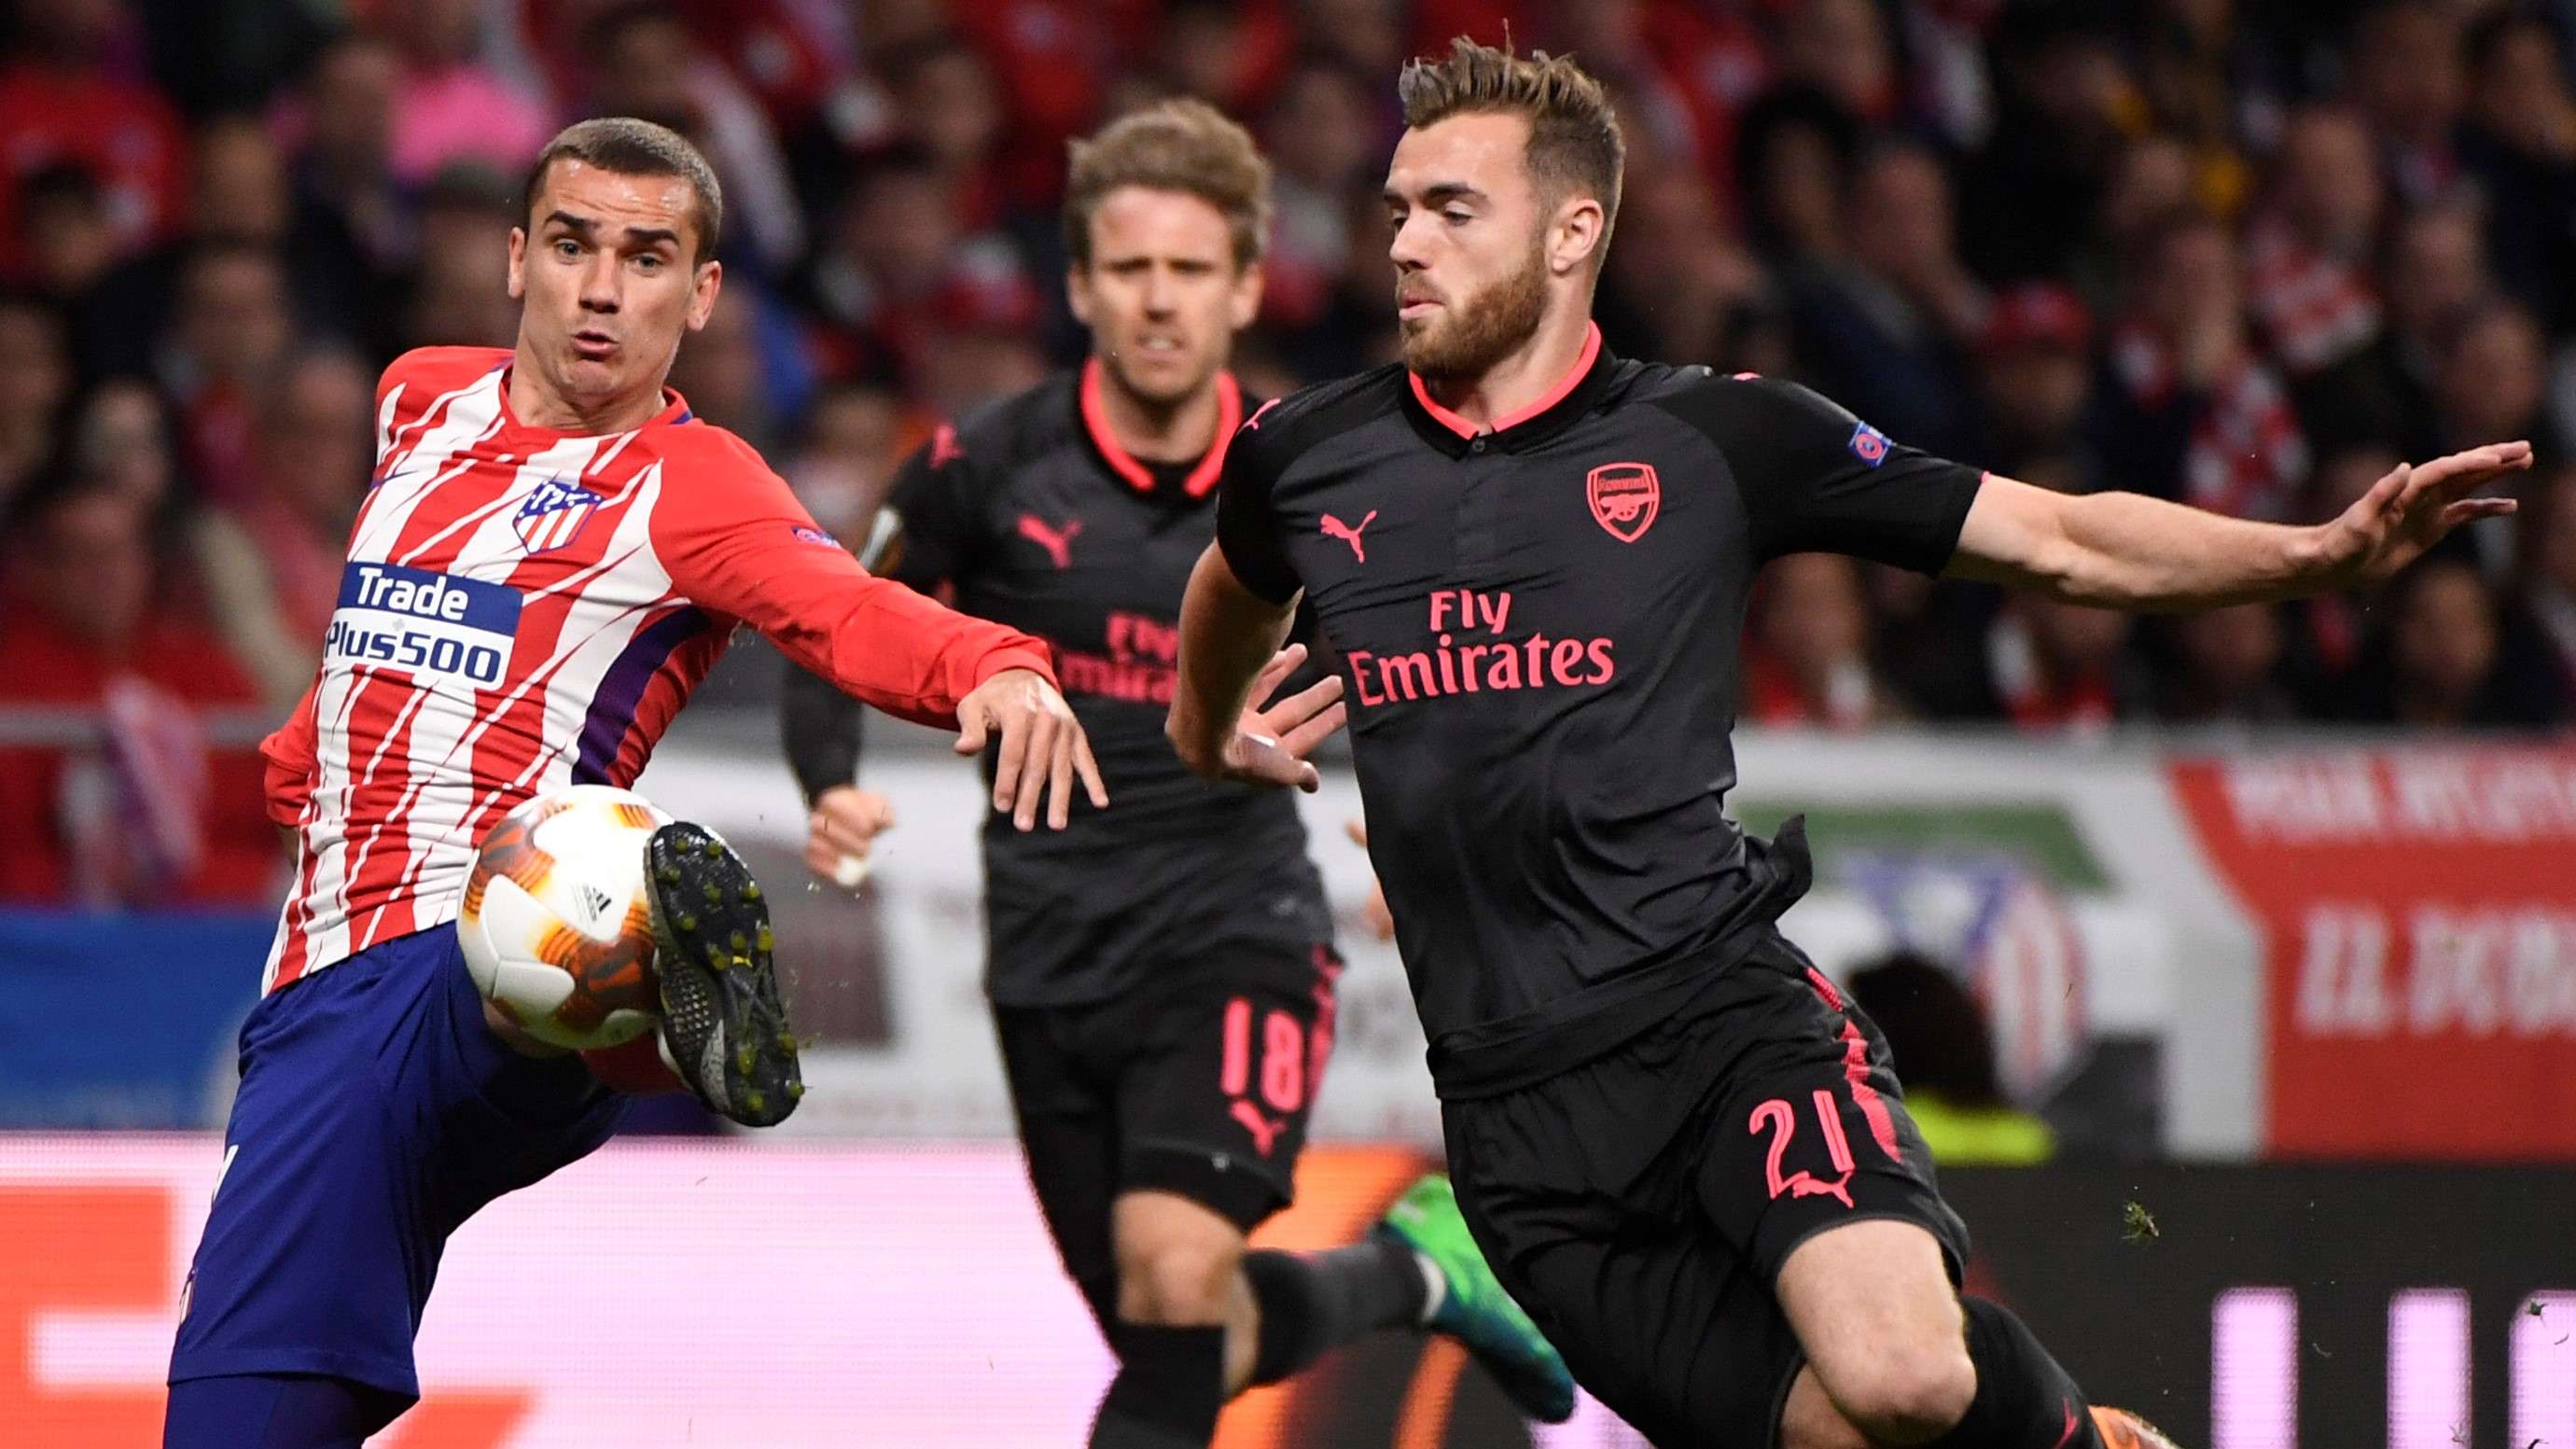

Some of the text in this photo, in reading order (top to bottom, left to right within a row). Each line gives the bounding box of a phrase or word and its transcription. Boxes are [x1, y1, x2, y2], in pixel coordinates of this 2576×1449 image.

[357, 567, 469, 621] Trade
[1429, 589, 1512, 634] Fly
[325, 620, 502, 684] Plus500
[1347, 632, 1615, 707] Emirates
[1220, 996, 1305, 1113] 18
[1749, 1090, 1856, 1200] 21
